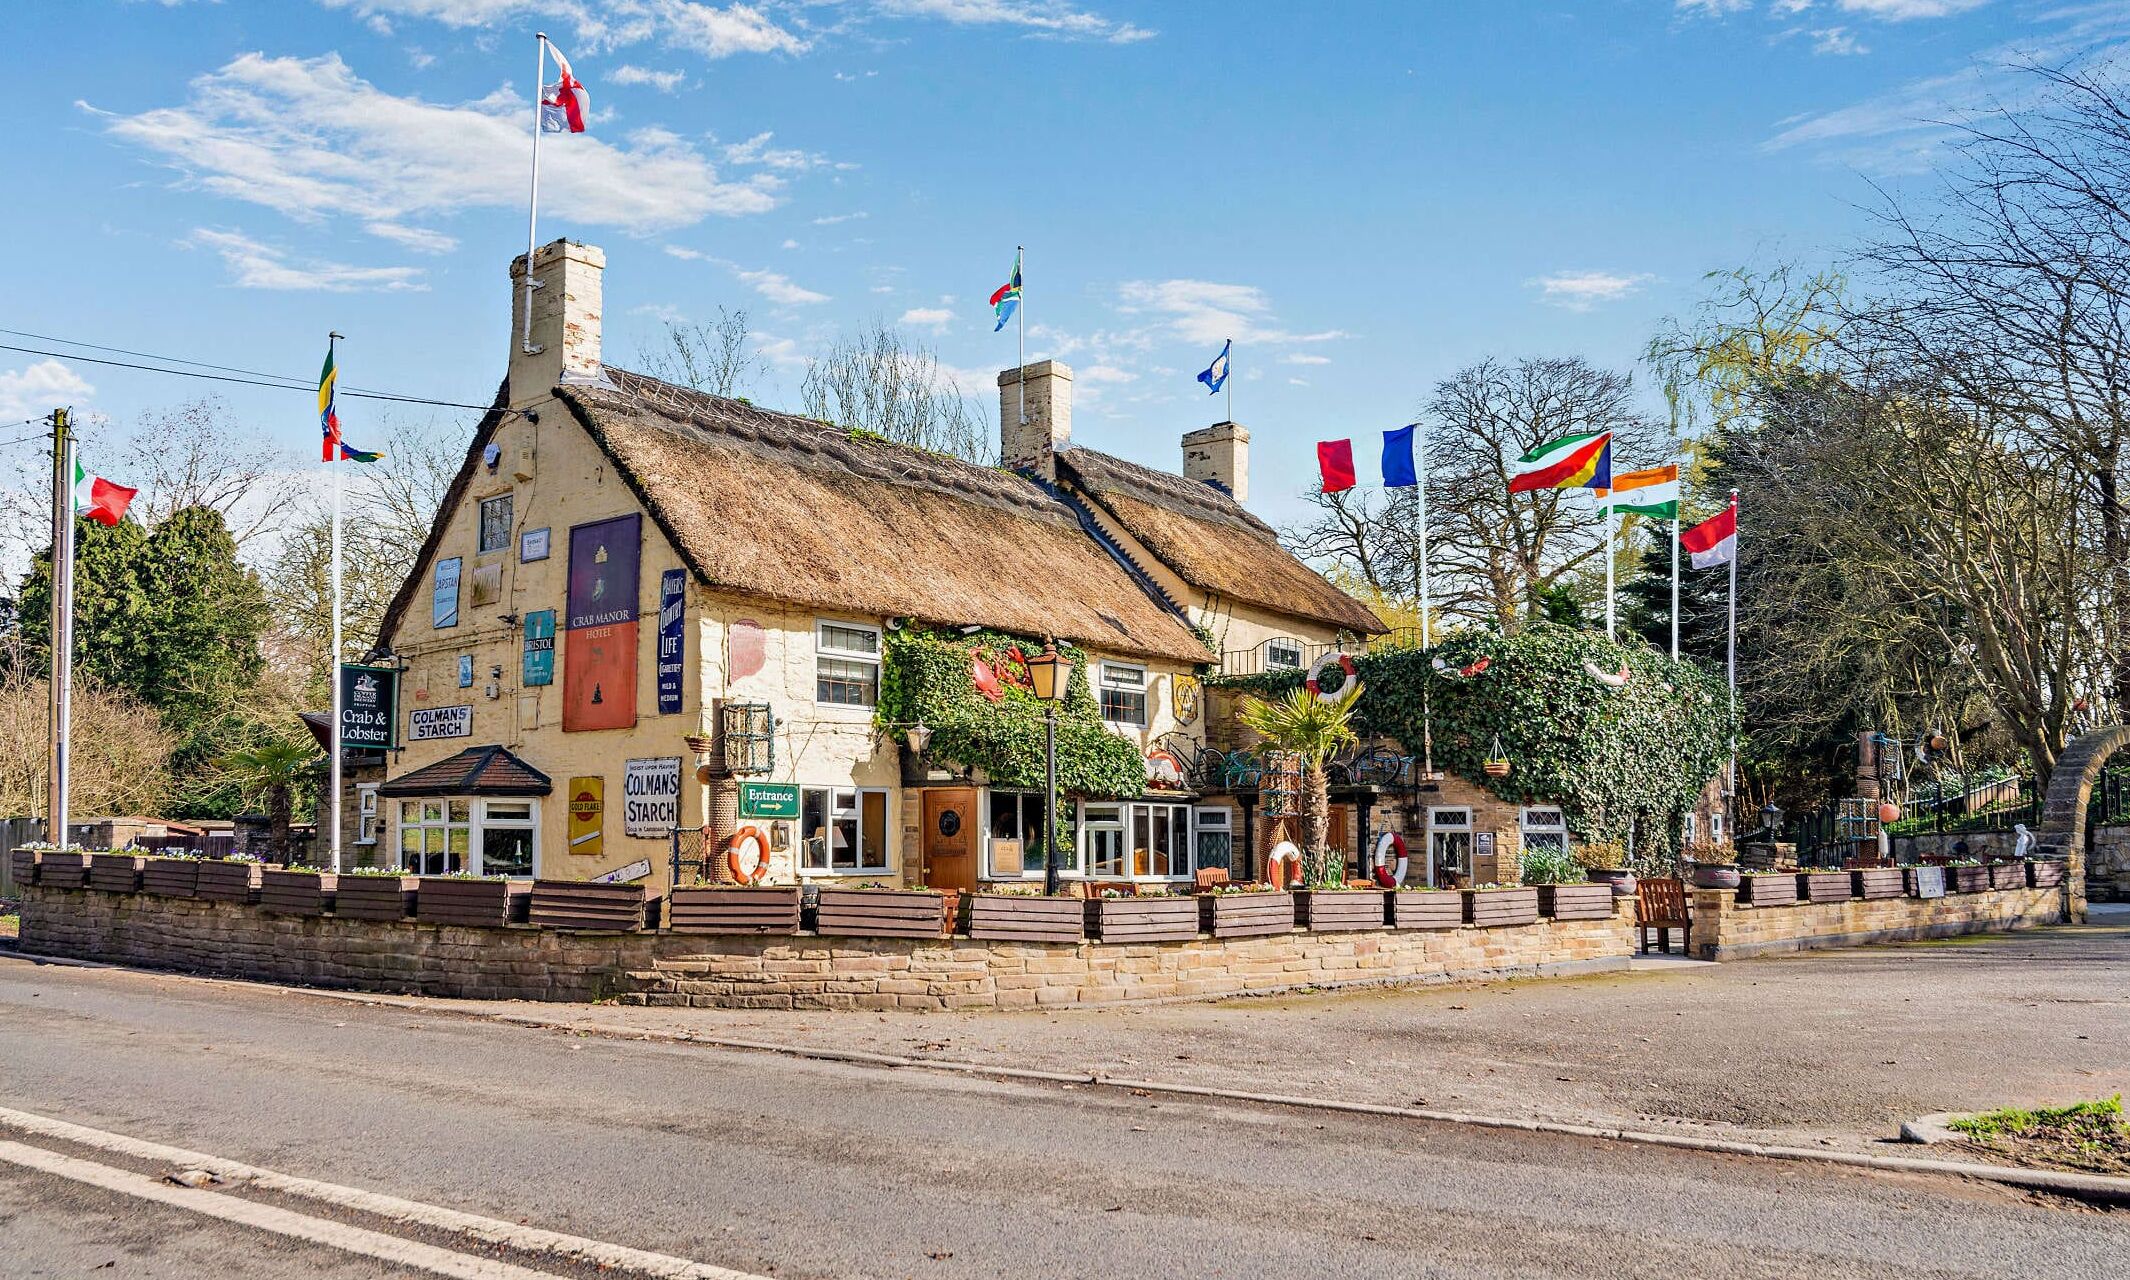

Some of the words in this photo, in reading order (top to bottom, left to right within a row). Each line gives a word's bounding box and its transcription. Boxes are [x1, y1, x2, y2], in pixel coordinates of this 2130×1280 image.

[573, 615, 594, 627] CRAB
[595, 610, 630, 624] MANOR
[586, 628, 612, 639] HOTEL
[524, 639, 553, 651] BRISTOL
[661, 635, 678, 657] LIFE
[342, 709, 373, 725] Crab
[375, 711, 387, 725] &
[341, 725, 388, 741] Lobster
[418, 722, 462, 737] STARCH
[626, 771, 677, 796] COLMAN'S
[748, 788, 794, 801] Entrance
[571, 802, 584, 811] GOLD
[584, 802, 600, 811] FLAKE
[628, 800, 675, 822] STARCH
